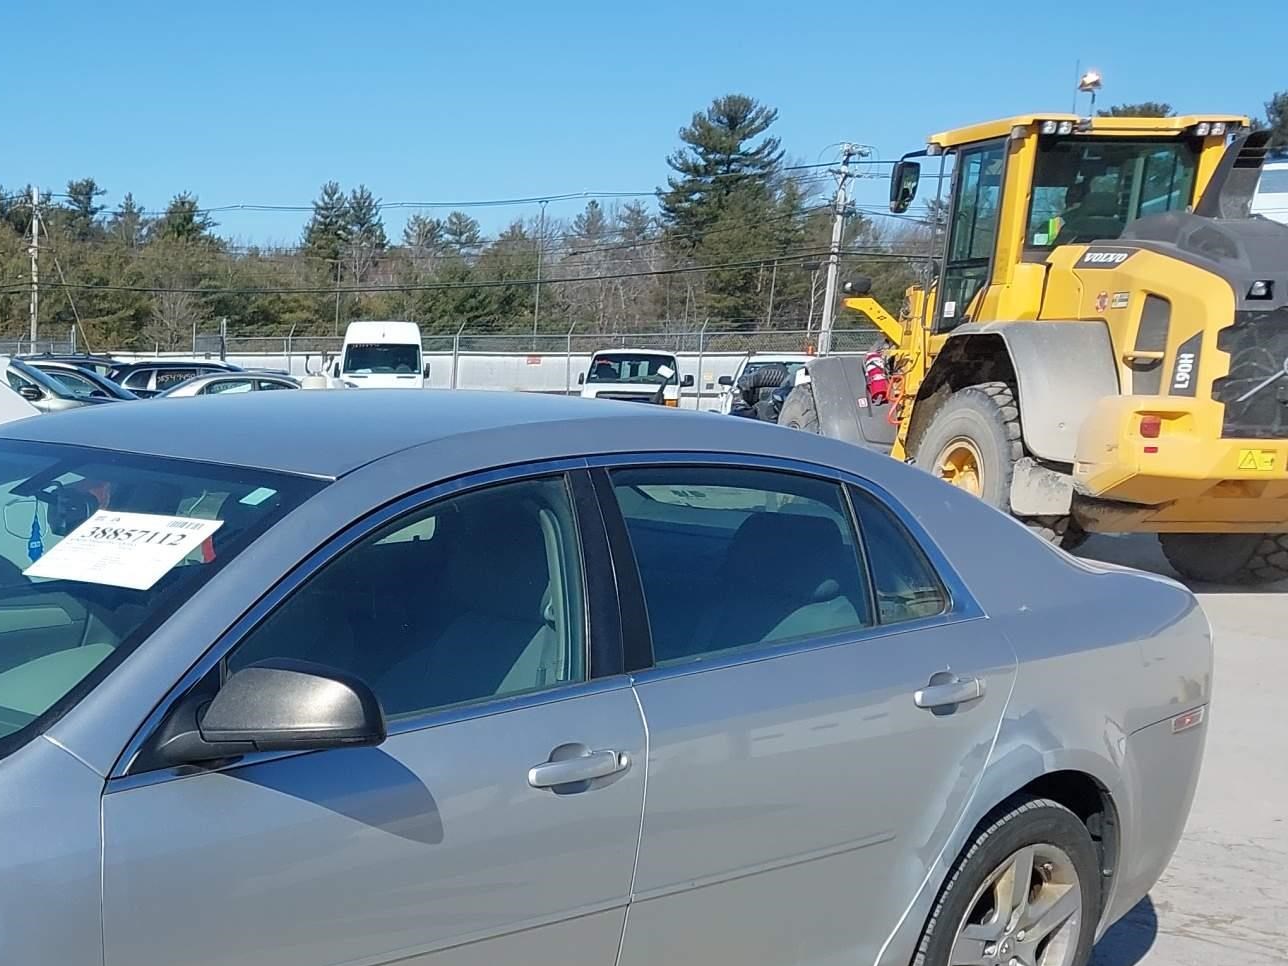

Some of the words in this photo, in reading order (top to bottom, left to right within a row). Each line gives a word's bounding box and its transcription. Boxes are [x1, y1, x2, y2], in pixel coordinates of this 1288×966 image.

[1084, 252, 1129, 263] VOLVO
[1173, 353, 1195, 389] L90H
[80, 526, 187, 546] 38857112
